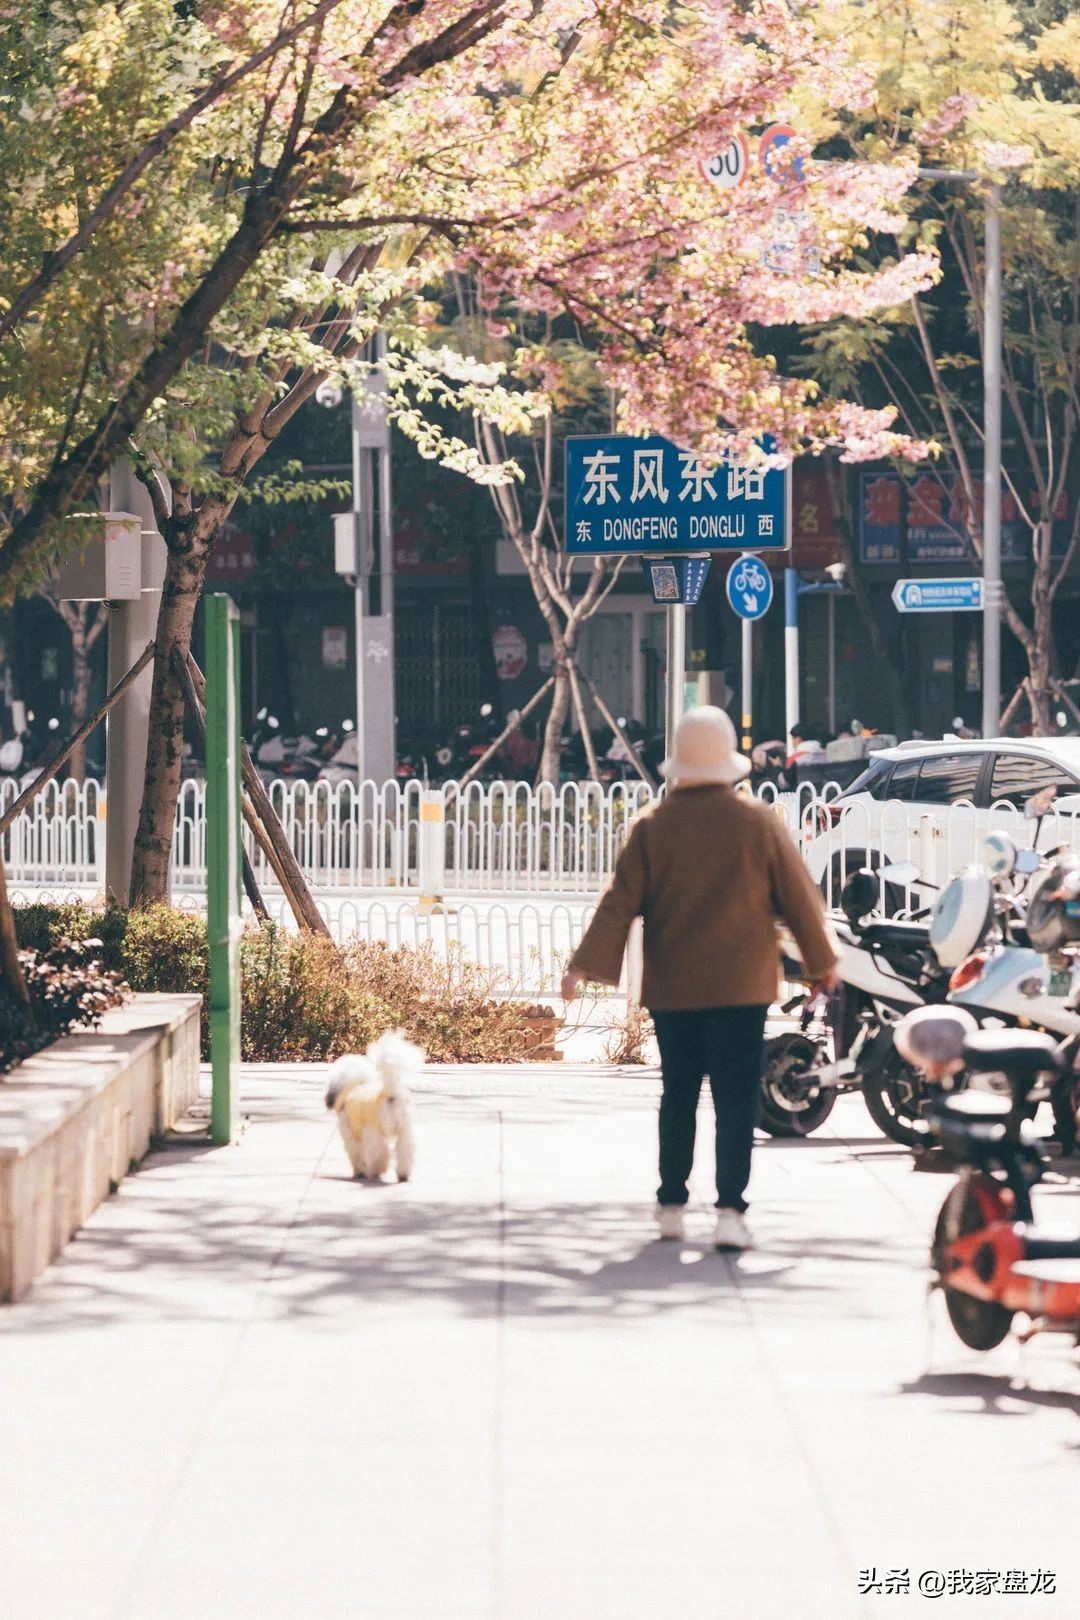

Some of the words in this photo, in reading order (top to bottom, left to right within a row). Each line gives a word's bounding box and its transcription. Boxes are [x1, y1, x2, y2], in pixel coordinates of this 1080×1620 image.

[582, 447, 766, 506] 东风东路
[575, 520, 592, 543] 东
[603, 516, 678, 541] DONGFENG
[689, 514, 746, 539] DONGLU
[757, 514, 775, 537] 西
